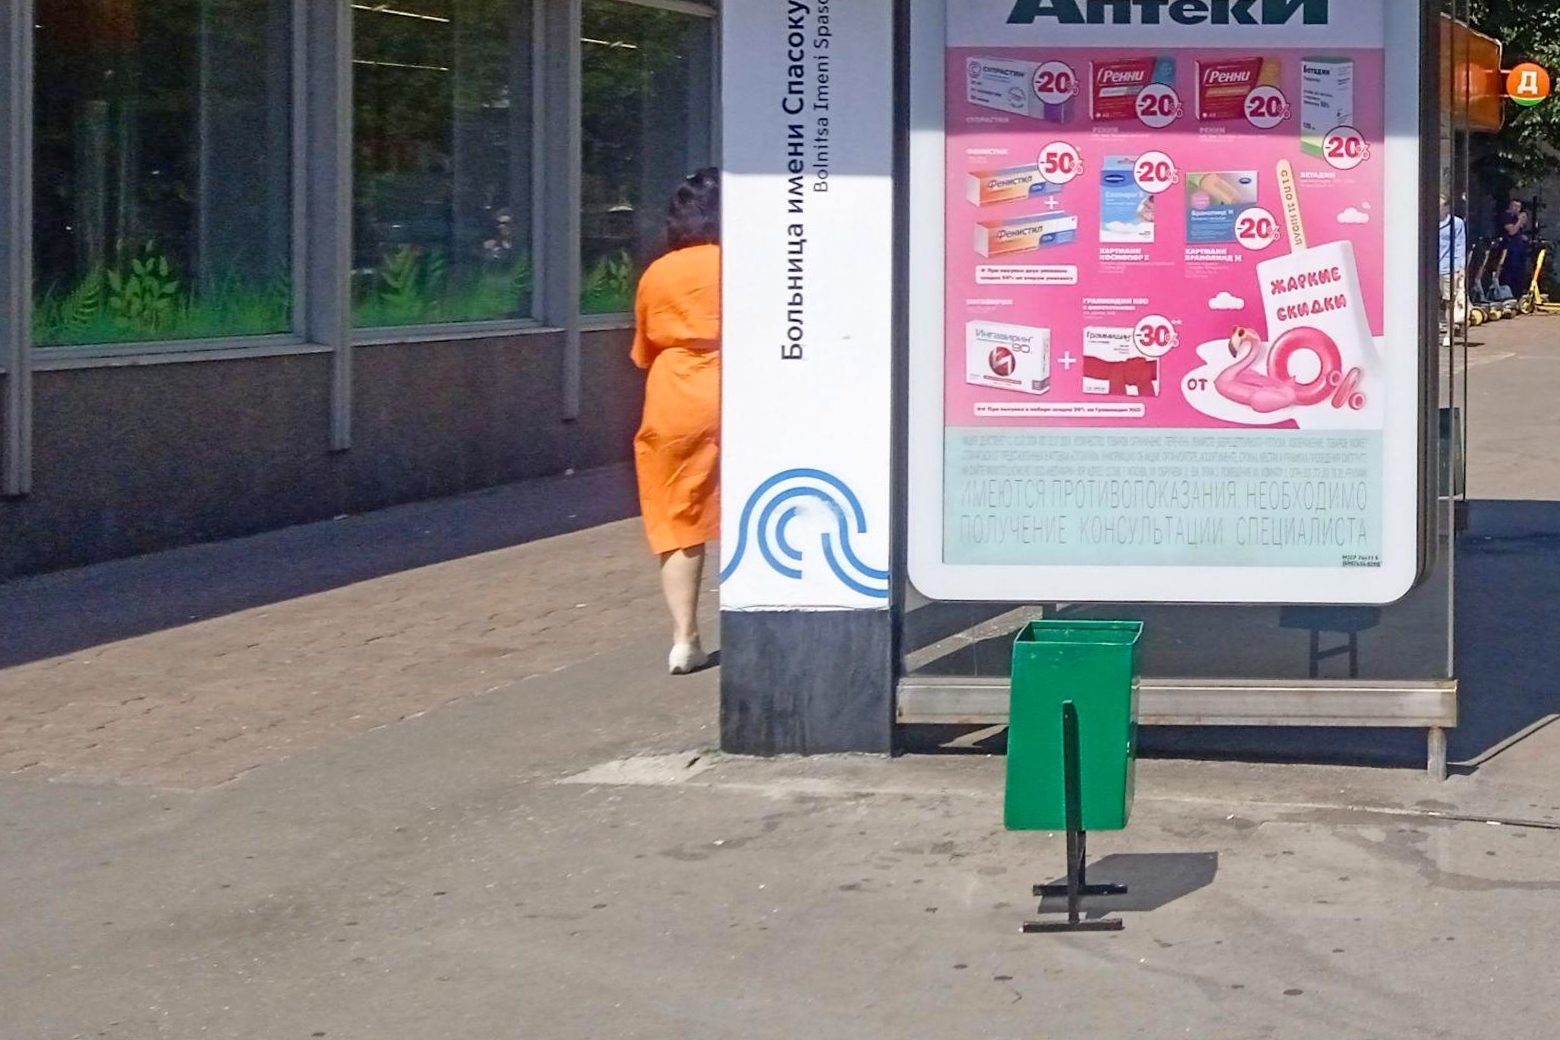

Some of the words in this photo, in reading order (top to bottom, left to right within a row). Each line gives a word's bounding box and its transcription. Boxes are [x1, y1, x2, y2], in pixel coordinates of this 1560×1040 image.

[812, 55, 831, 112] Imeni
[1035, 71, 1079, 96] -20%
[1103, 69, 1145, 83] Ренни
[1208, 70, 1250, 83] Ренни
[1517, 70, 1538, 94] Д
[1138, 94, 1183, 118] -20%
[1247, 96, 1290, 119] -20%
[812, 119, 831, 193] Bolnitsa
[1325, 137, 1370, 160] -20%
[787, 124, 805, 214] имени
[1137, 162, 1180, 184] -20%
[987, 176, 1033, 189] Фенистил
[996, 226, 1043, 239] Фенистил
[1237, 217, 1281, 240] -20%
[781, 223, 808, 361] Больница
[1270, 266, 1342, 295] ЖАРКИЕ
[1276, 294, 1347, 322] СКИДКИ
[1011, 343, 1031, 354] 90
[961, 479, 1046, 509] ИМЕЮТСЯ
[1246, 480, 1367, 513] НЕОБХОДИМО
[960, 514, 1067, 545] ПОЛУЧЕНИЕ
[1079, 515, 1224, 547] КОНСУЛЬТАЦИИ
[1236, 516, 1367, 548] СПЕЦИАЛИСТА
